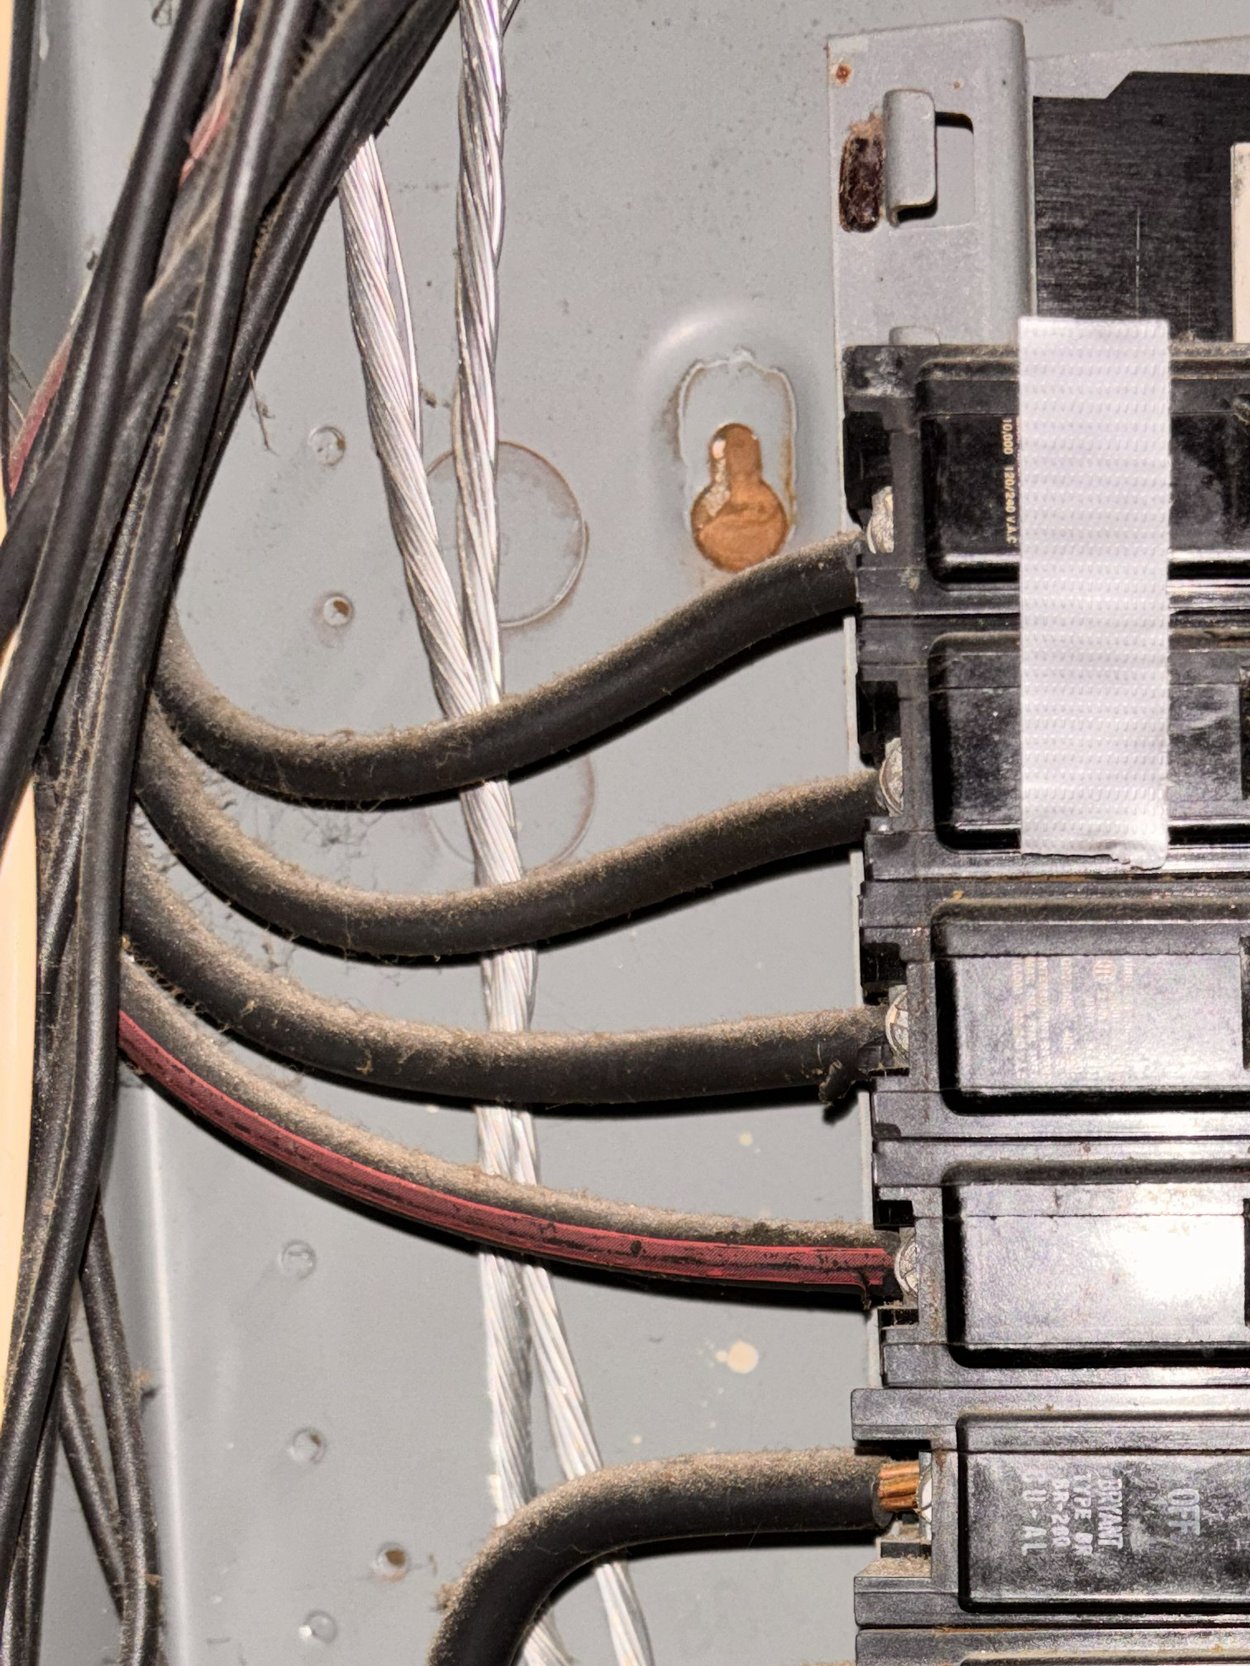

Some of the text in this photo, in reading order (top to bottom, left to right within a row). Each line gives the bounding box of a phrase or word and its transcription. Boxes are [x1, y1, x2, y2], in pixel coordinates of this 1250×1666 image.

[1002, 419, 1016, 513] 10,000 120/240
[1073, 1471, 1093, 1520] TYPE
[1097, 1478, 1123, 1549] BRYANT
[1167, 1488, 1201, 1535] OFF
